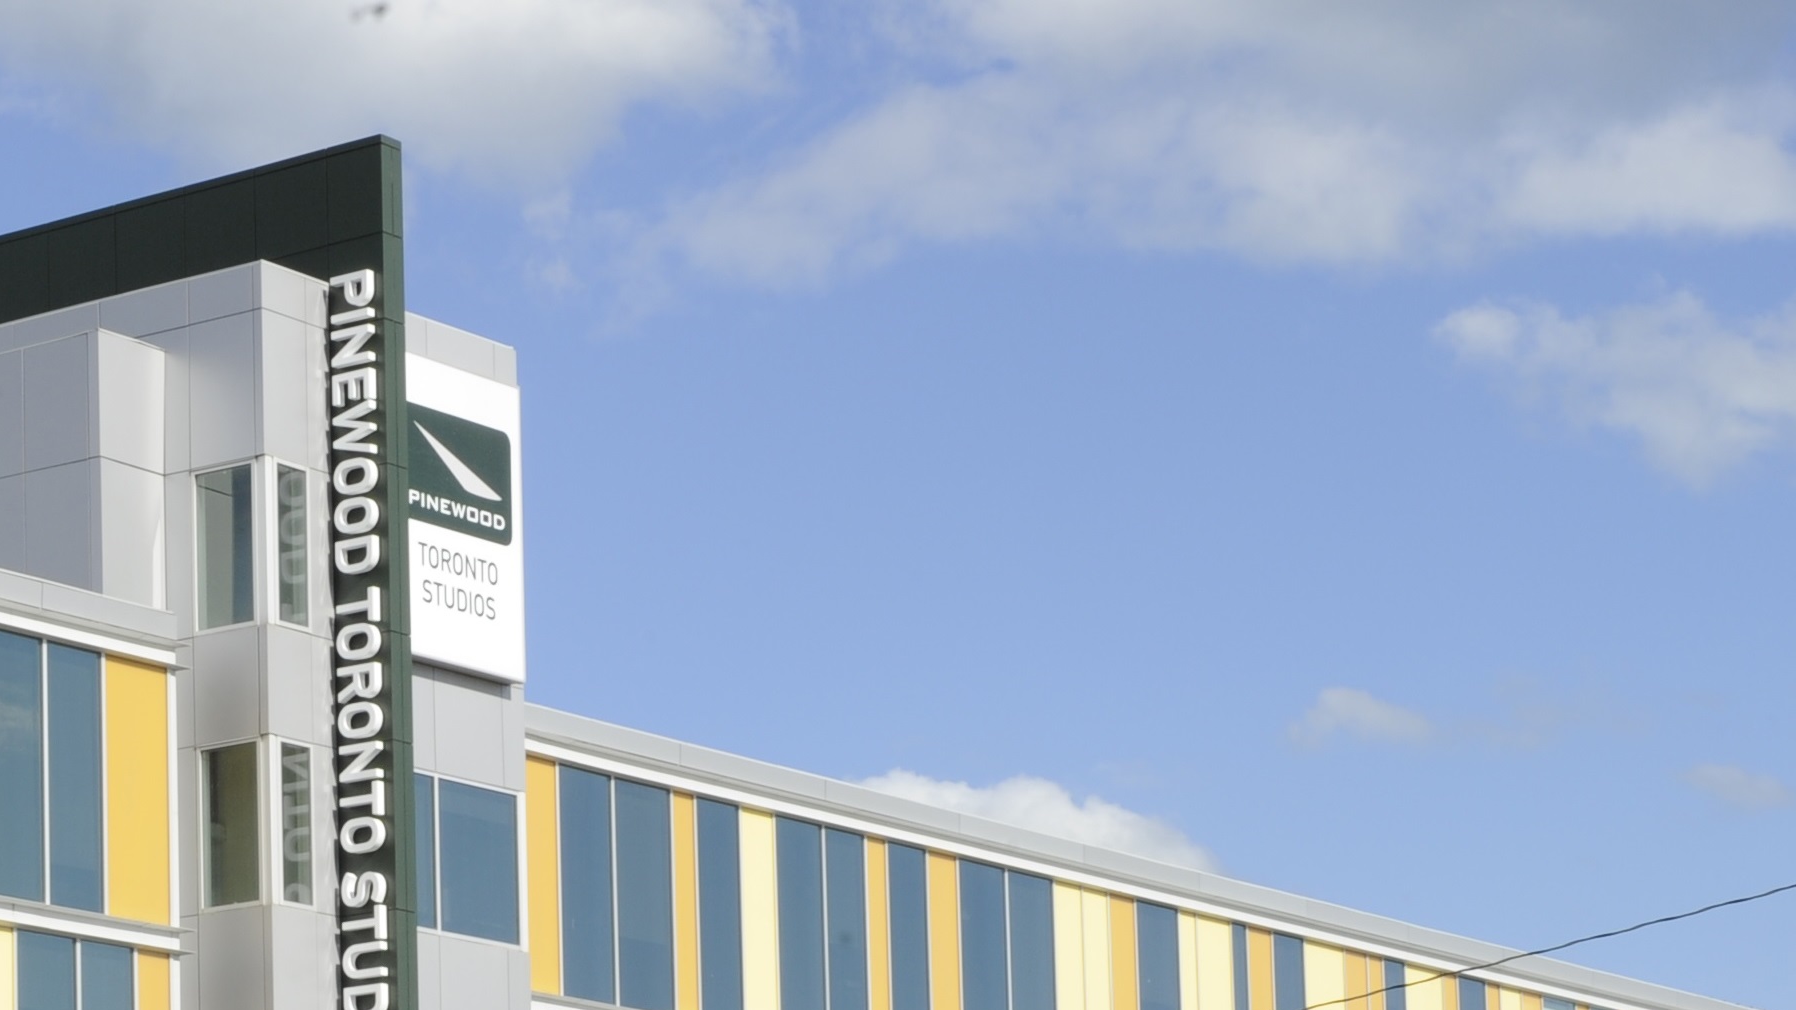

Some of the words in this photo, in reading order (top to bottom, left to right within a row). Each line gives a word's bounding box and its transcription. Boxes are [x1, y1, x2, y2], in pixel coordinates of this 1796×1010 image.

[330, 268, 380, 574] PINEWOOD
[408, 488, 505, 531] PINEWOOD
[418, 541, 498, 586] TORONTO
[422, 580, 496, 620] STUDIOS
[336, 585, 386, 855] TORONTO
